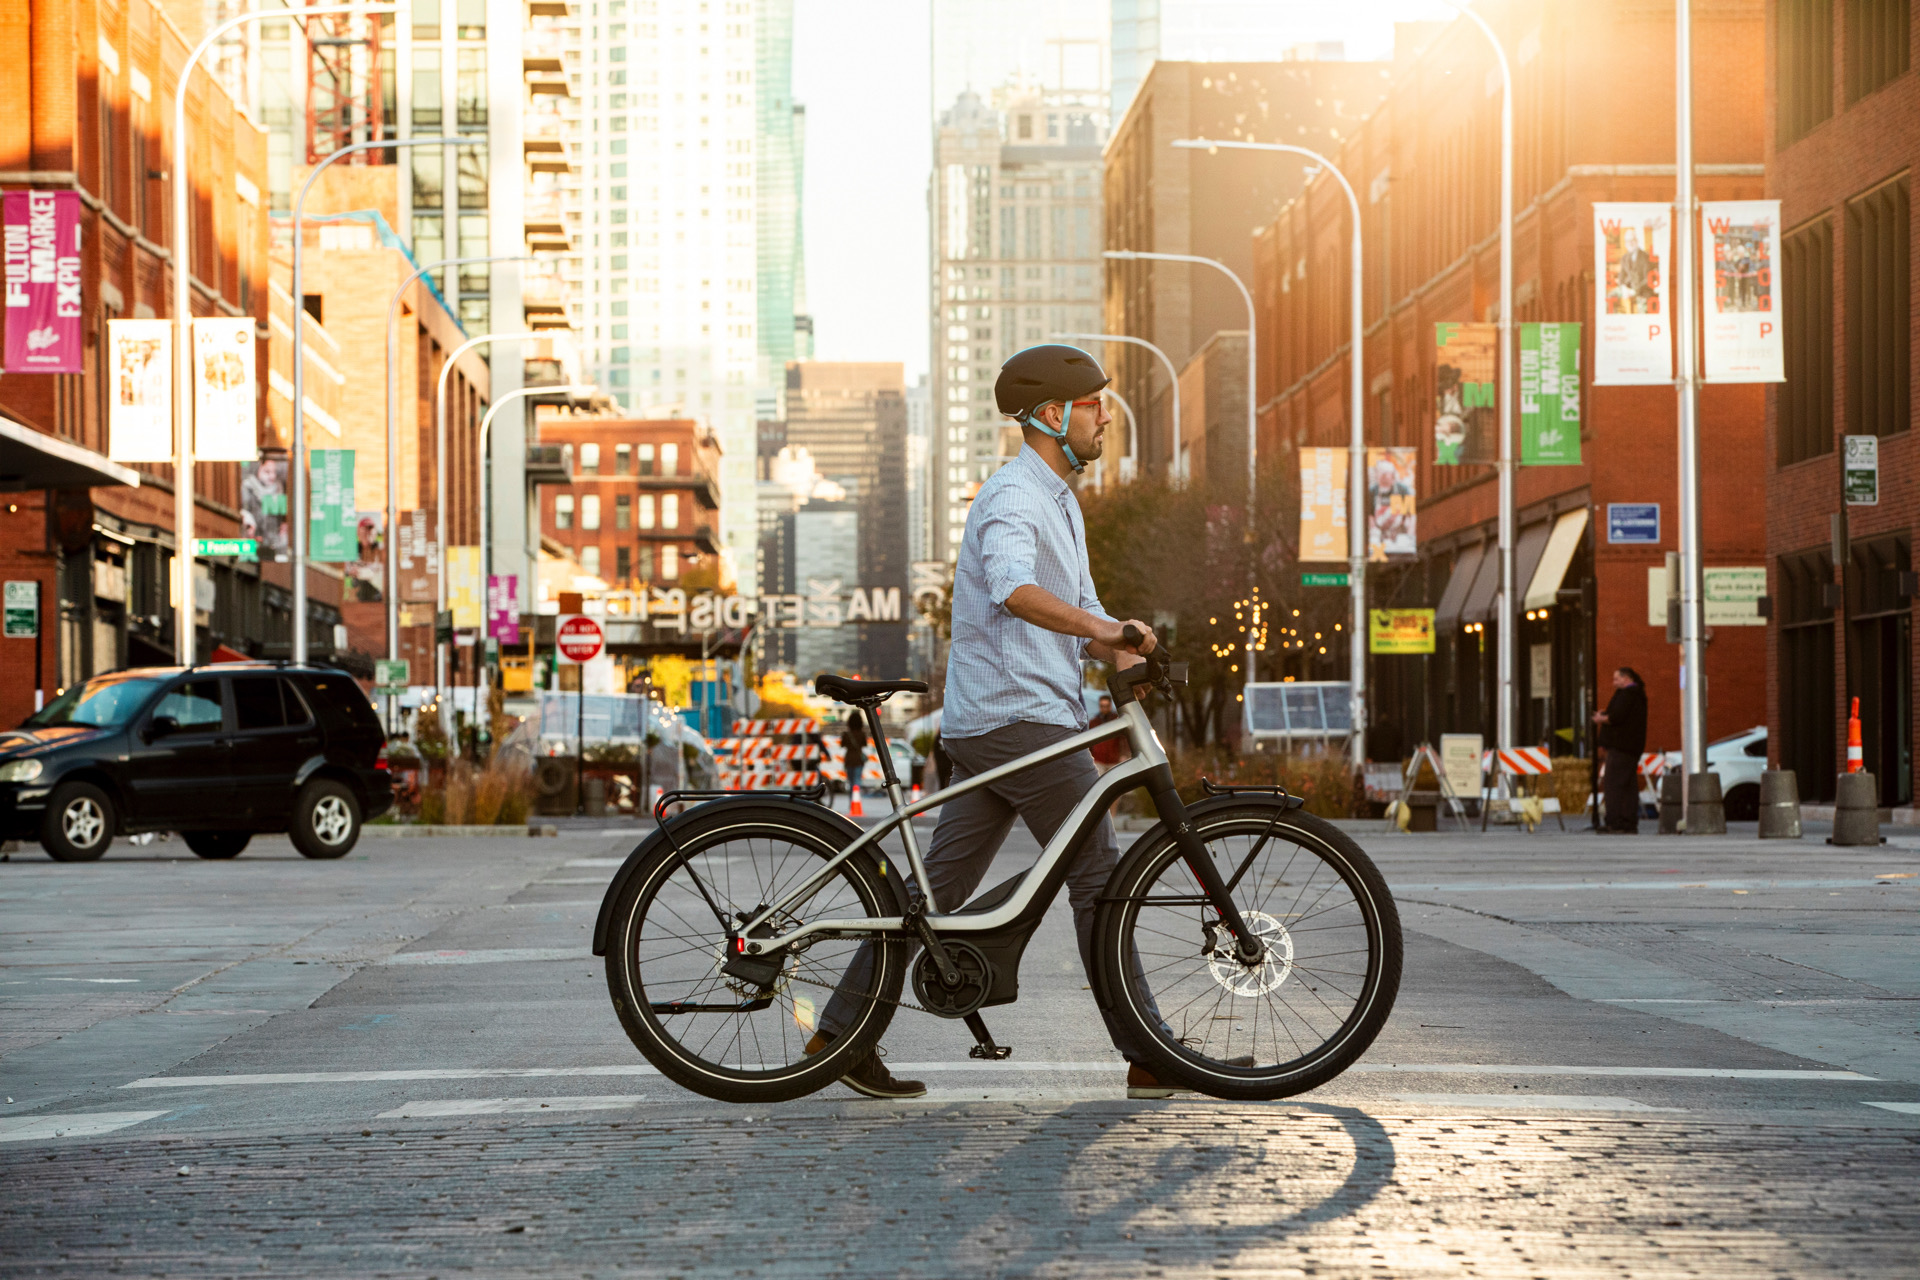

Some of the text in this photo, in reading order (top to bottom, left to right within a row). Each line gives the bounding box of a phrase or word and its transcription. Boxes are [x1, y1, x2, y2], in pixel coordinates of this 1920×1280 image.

[4, 225, 30, 307] FULTON
[29, 190, 56, 283] MARKET
[1708, 217, 1730, 314] WEST
[57, 257, 81, 317] EXPO
[1757, 241, 1773, 338] LOOP
[1520, 350, 1540, 413] FULTON
[1540, 323, 1561, 395] MARKET
[1463, 383, 1494, 408] M
[1561, 375, 1580, 421] EXPO
[1436, 441, 1459, 465] X
[563, 623, 597, 633] DO NOT
[567, 644, 594, 655] ENTER
